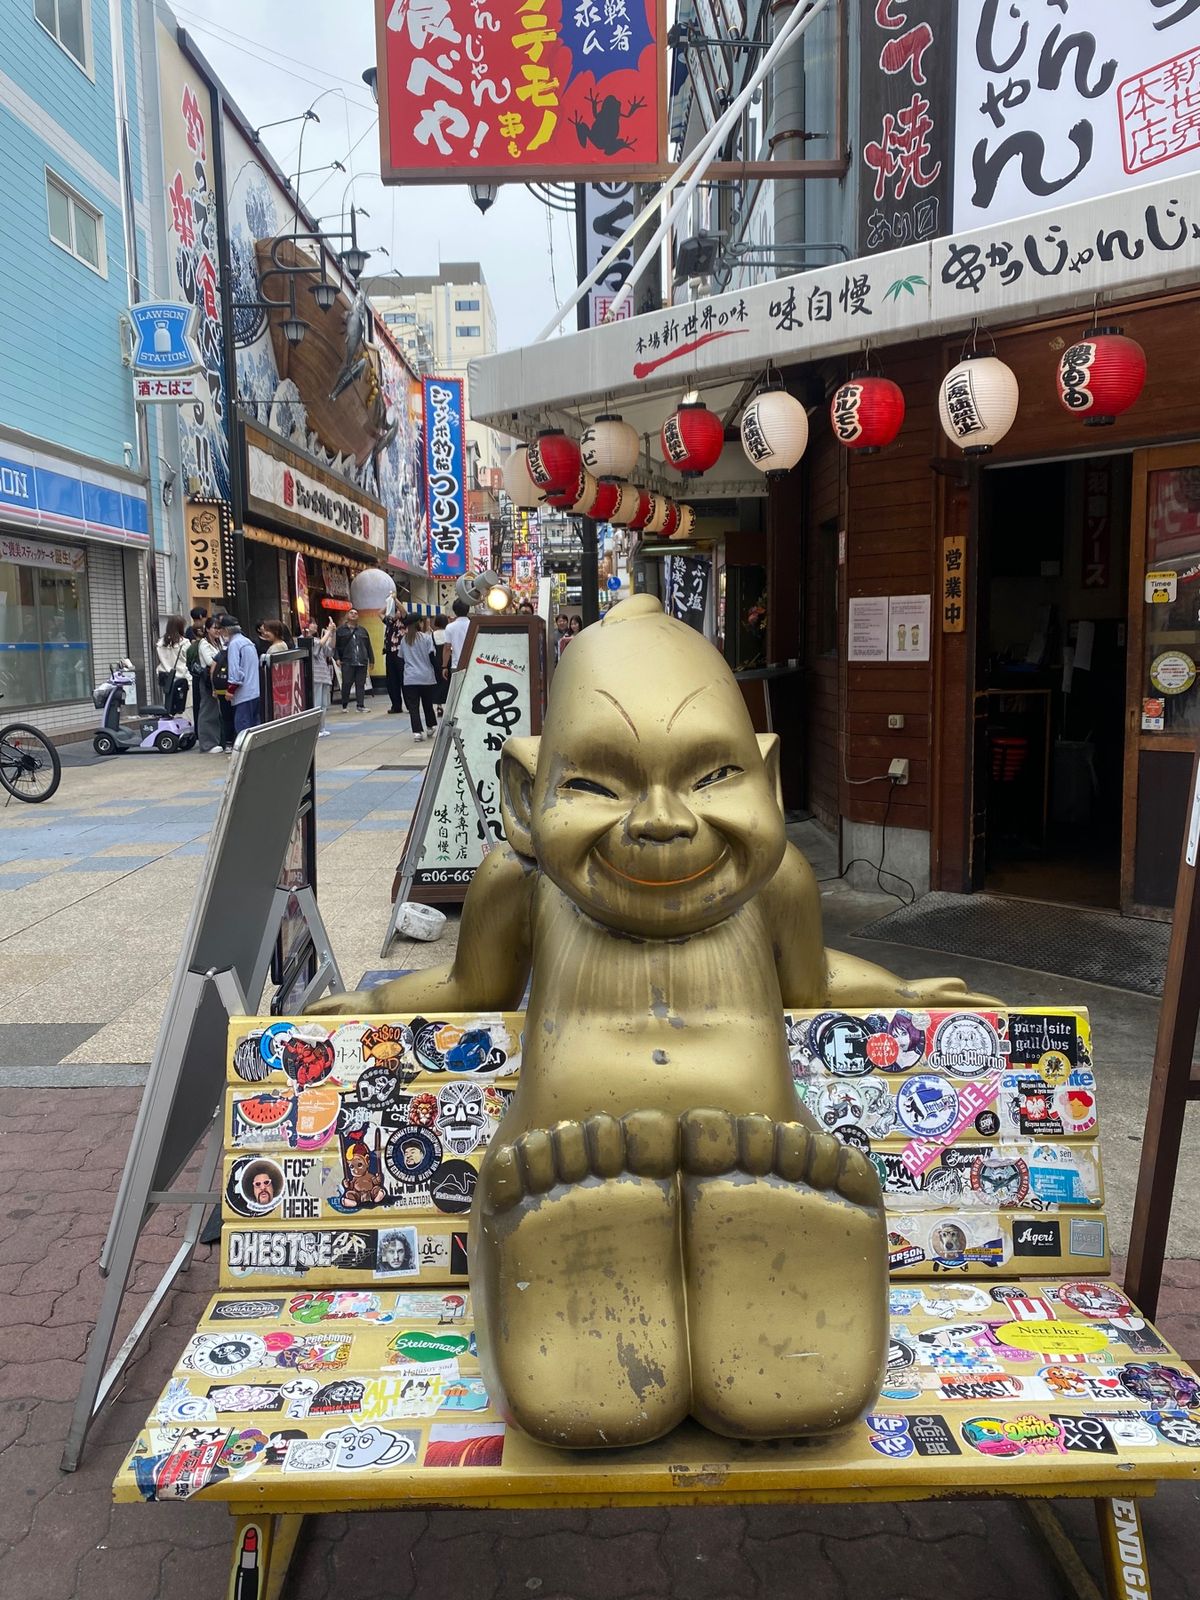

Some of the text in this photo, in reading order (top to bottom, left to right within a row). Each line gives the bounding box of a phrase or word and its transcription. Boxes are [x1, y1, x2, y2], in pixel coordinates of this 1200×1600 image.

[1124, 78, 1167, 168] 本店
[137, 309, 186, 324] LAWSON
[635, 274, 873, 354] 本場新世界の味 味自慢
[139, 350, 188, 364] STATION
[137, 379, 193, 396] 酒・たばこ
[834, 384, 862, 440] ホルモン
[0, 467, 29, 498] ON
[190, 538, 211, 590] つり吉
[945, 547, 962, 625] 営業中
[1151, 580, 1172, 588] Timee
[434, 804, 451, 854] 味自慢
[282, 1198, 319, 1218] HERE
[1018, 1227, 1054, 1246] Ageri
[888, 1247, 923, 1263] ERSON
[1018, 1326, 1085, 1336] Nett hier.
[396, 1339, 465, 1355] Steiermark
[1085, 1379, 1103, 1389] I
[1091, 1389, 1131, 1399] KSR
[873, 1418, 903, 1431] KP
[1058, 1417, 1103, 1434] RO
[878, 1437, 907, 1454] KP
[1063, 1433, 1106, 1450] XY
